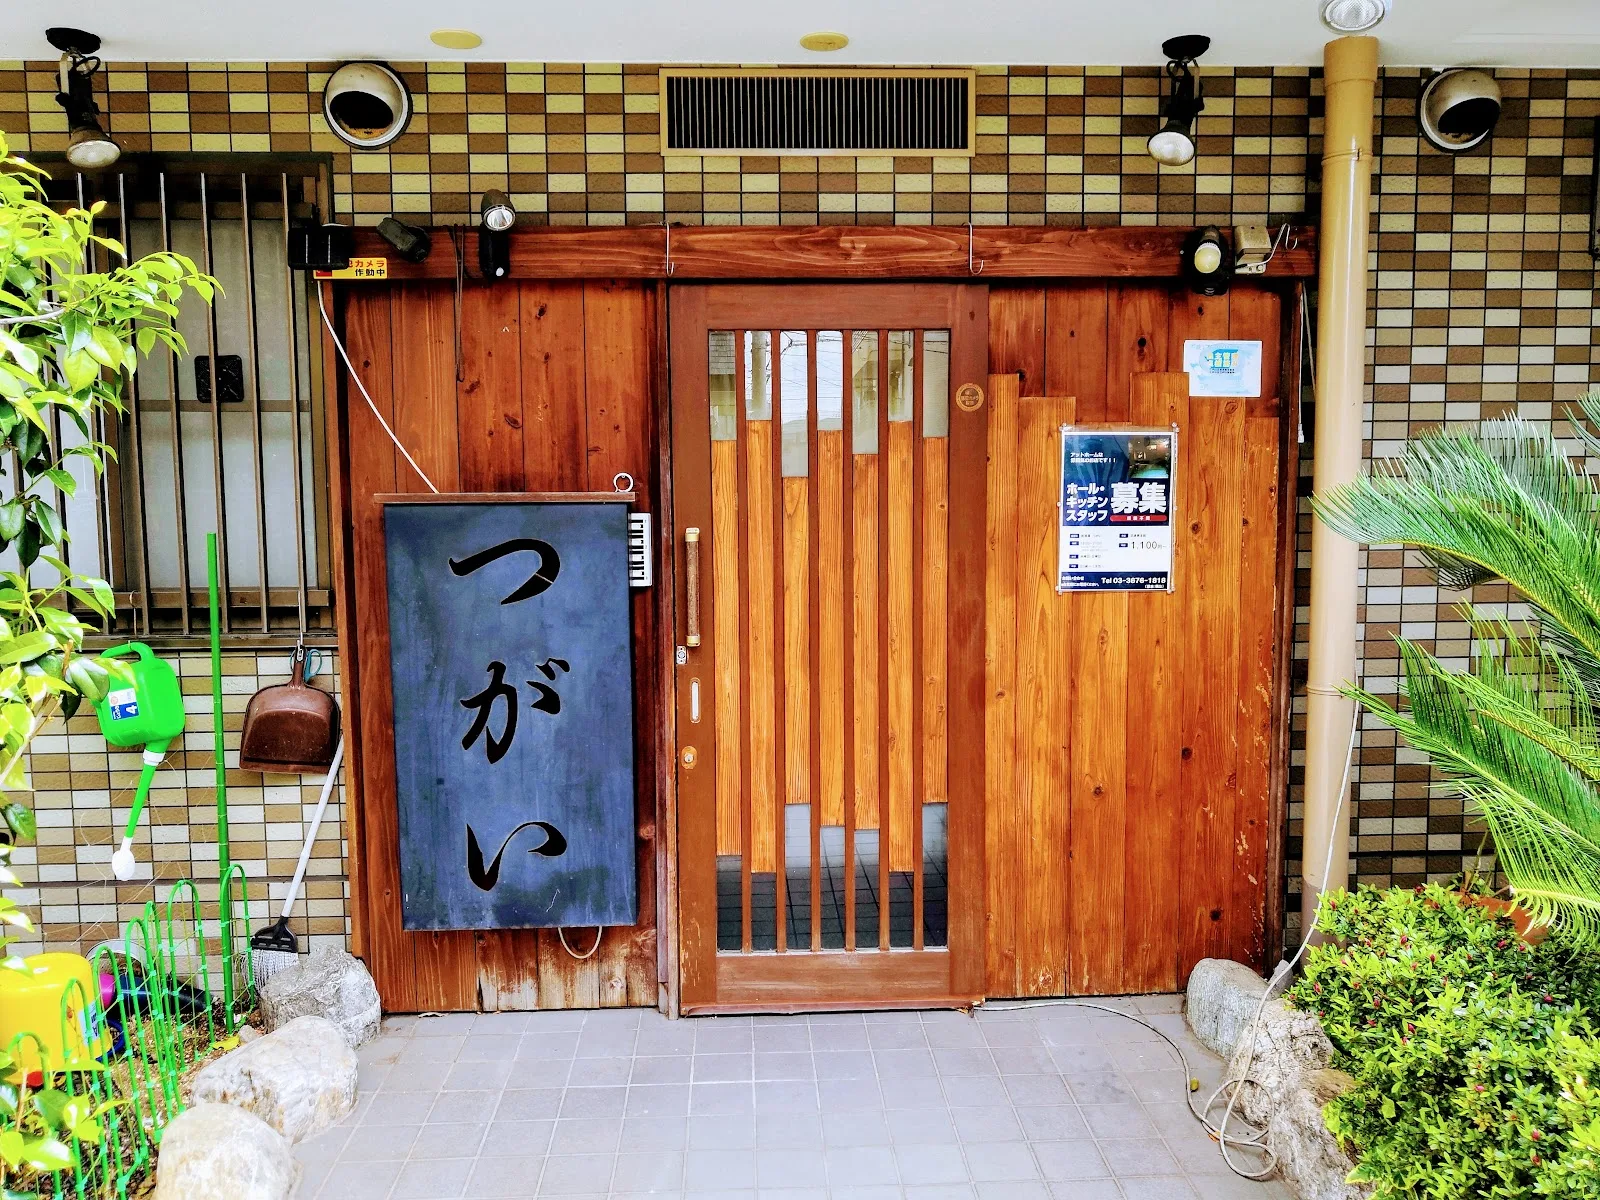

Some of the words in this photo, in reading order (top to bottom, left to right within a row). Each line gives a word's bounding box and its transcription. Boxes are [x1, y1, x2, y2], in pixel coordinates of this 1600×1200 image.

[355, 268, 385, 277] 作動中
[1066, 482, 1106, 495] ホール・
[1066, 496, 1108, 509] キッチン
[1110, 481, 1167, 514] 募集
[1065, 509, 1108, 522] スタッフ
[1100, 576, 1113, 584] Tel
[448, 538, 570, 892] つがい
